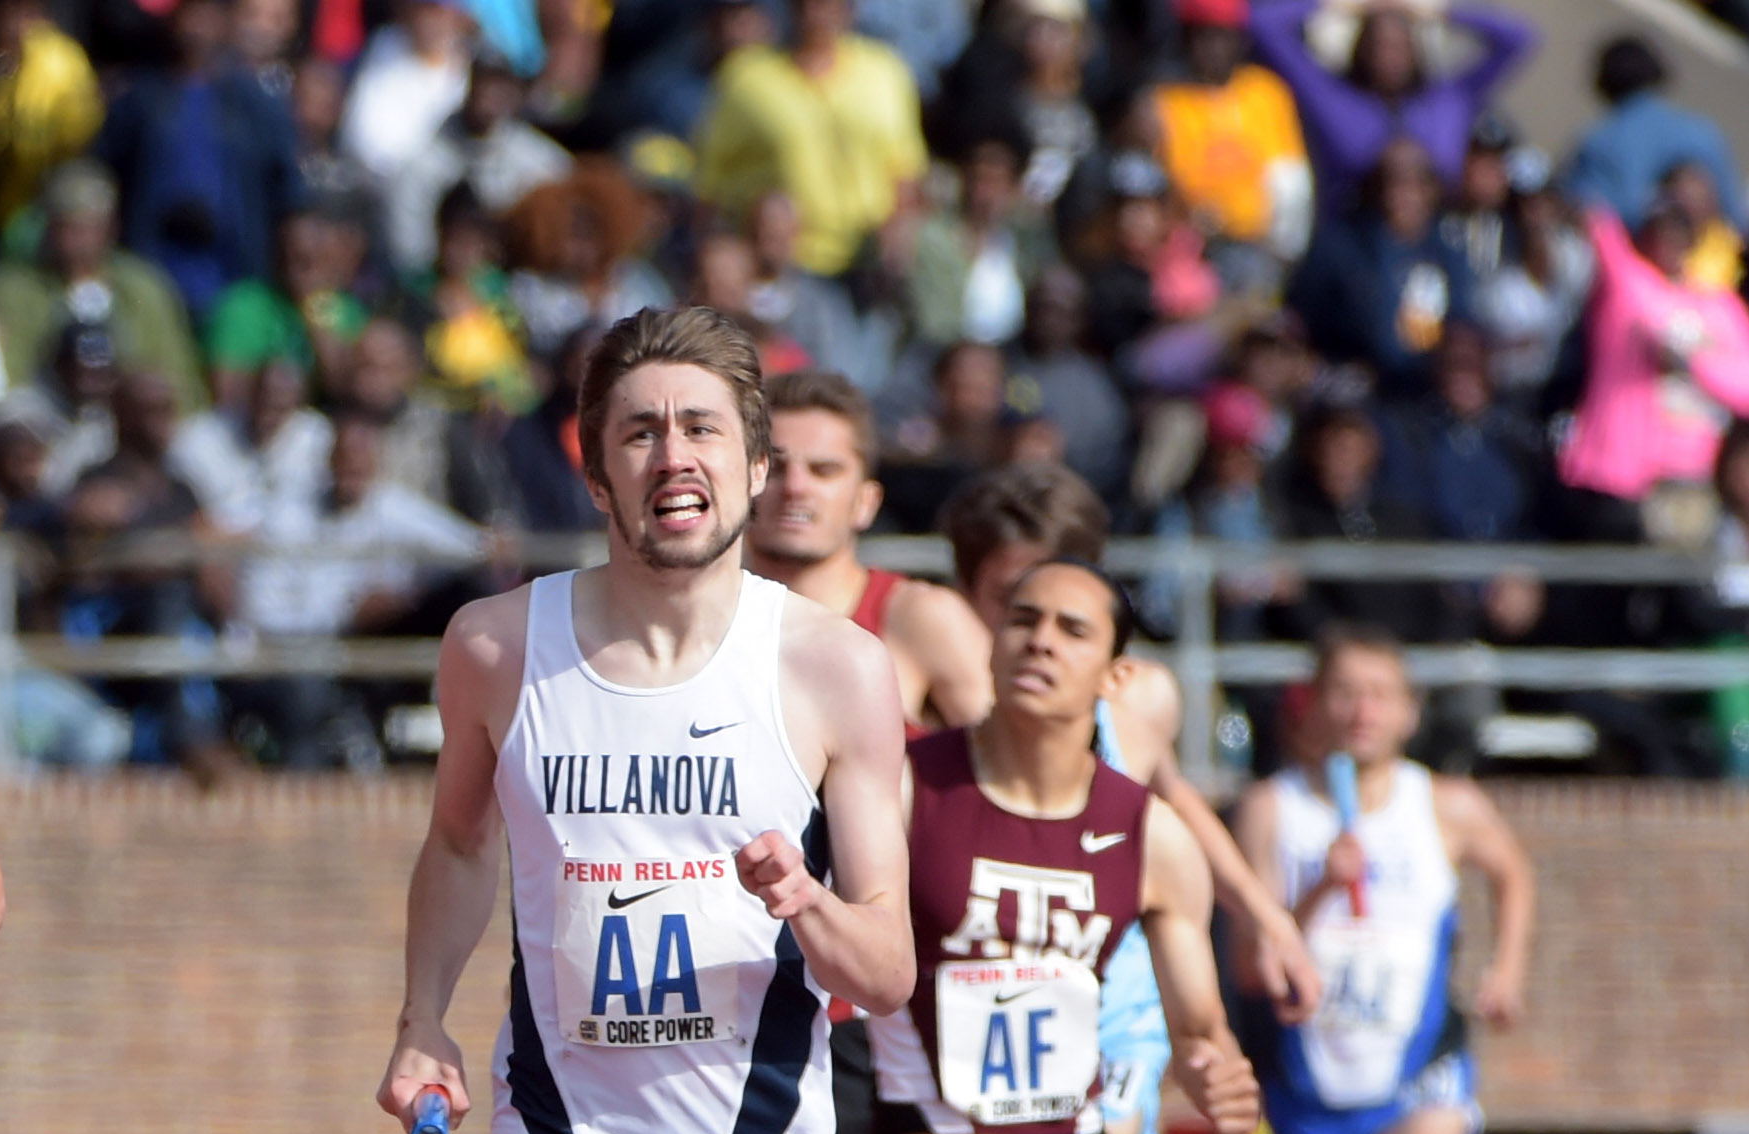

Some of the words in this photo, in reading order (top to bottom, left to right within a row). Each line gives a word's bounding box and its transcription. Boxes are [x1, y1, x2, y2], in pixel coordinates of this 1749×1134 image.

[541, 755, 740, 817] VILLANOVA
[564, 862, 622, 882] PENN
[635, 859, 726, 881] RELAYS
[591, 914, 702, 1016] AA
[606, 1020, 650, 1043] CORE
[654, 1016, 714, 1042] POWER
[980, 1008, 1056, 1094] AF
